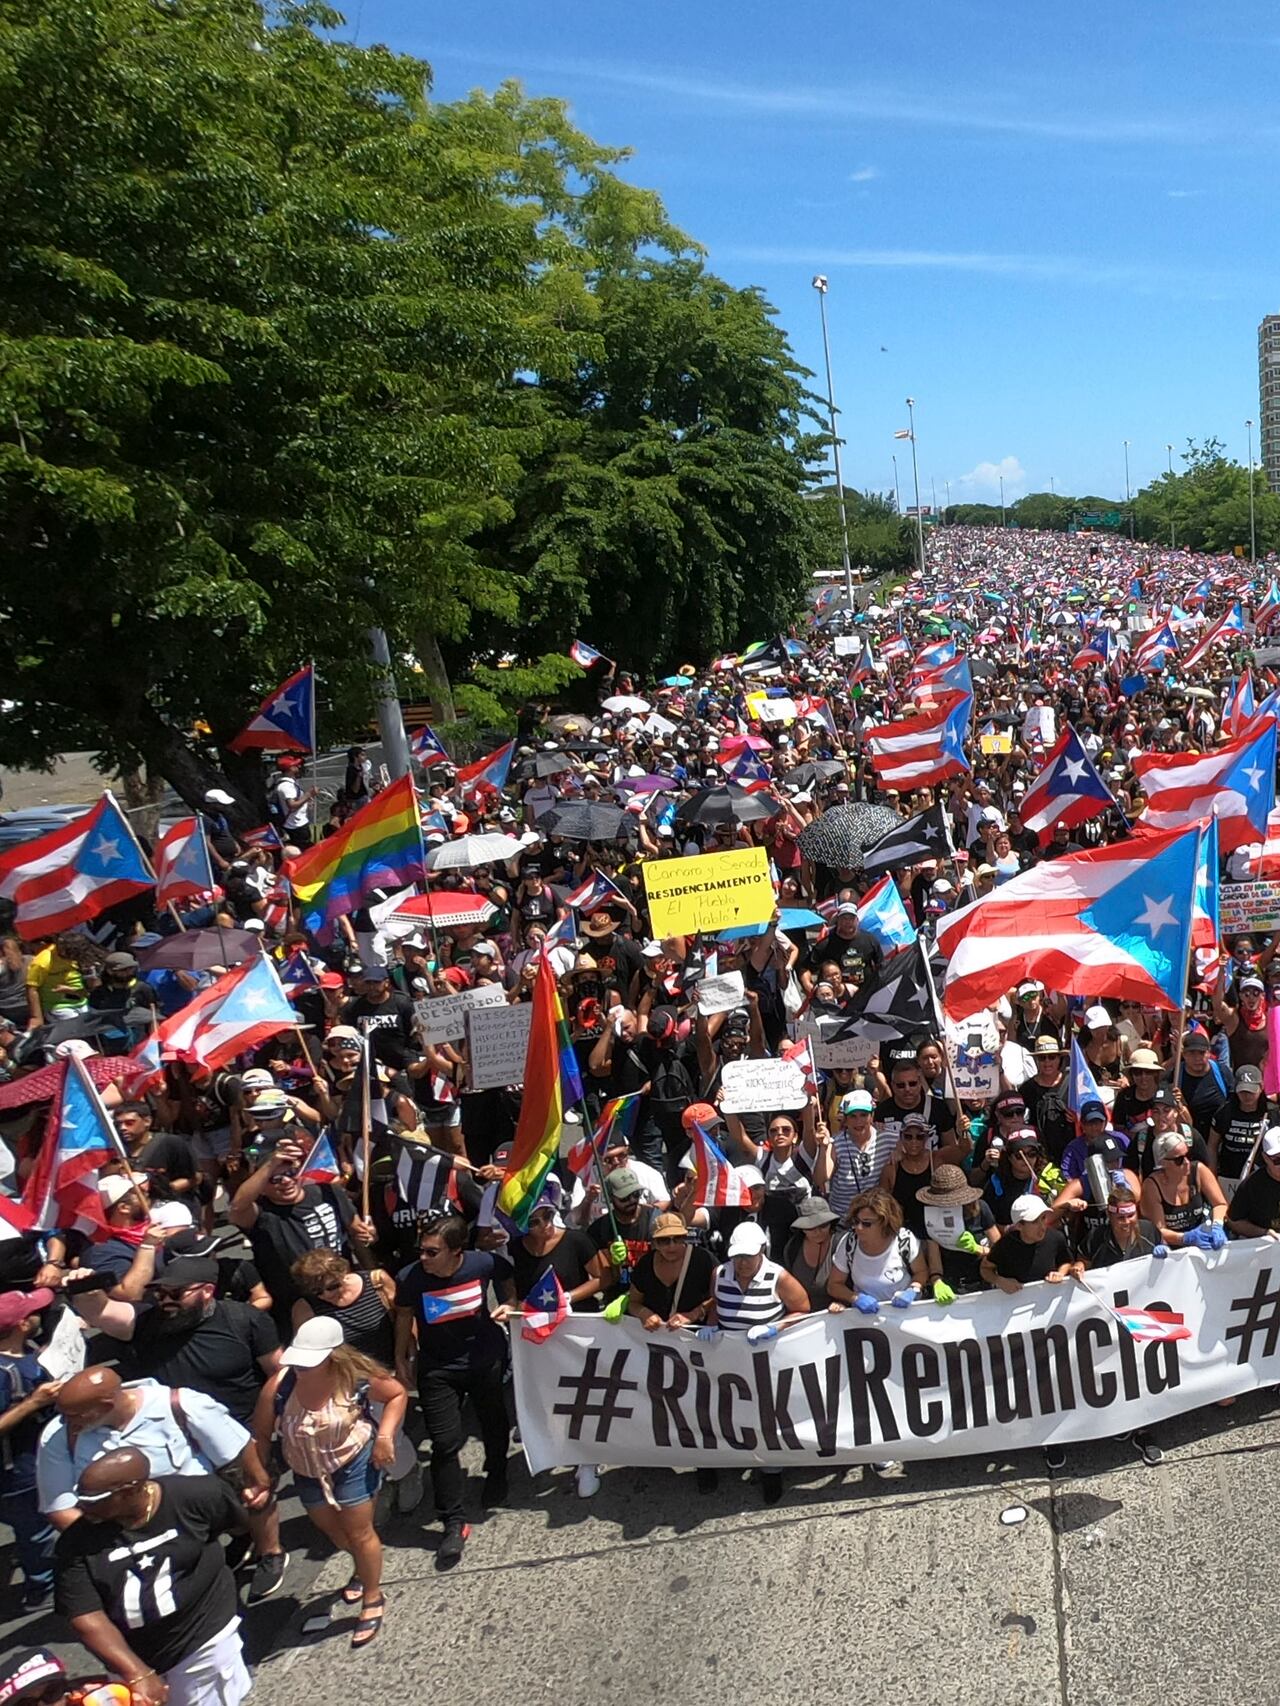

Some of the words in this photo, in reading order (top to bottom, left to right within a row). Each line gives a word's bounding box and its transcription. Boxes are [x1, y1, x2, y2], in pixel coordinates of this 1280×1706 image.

[647, 872, 768, 901] RESIDENCIAMIENTO!
[667, 900, 681, 915] El
[420, 995, 504, 1021] DESPEDIDO
[955, 1077, 972, 1089] Bad
[974, 1075, 992, 1090] Boy
[301, 1211, 325, 1240] 1987
[553, 1289, 1182, 1457] #RickyRenuncia
